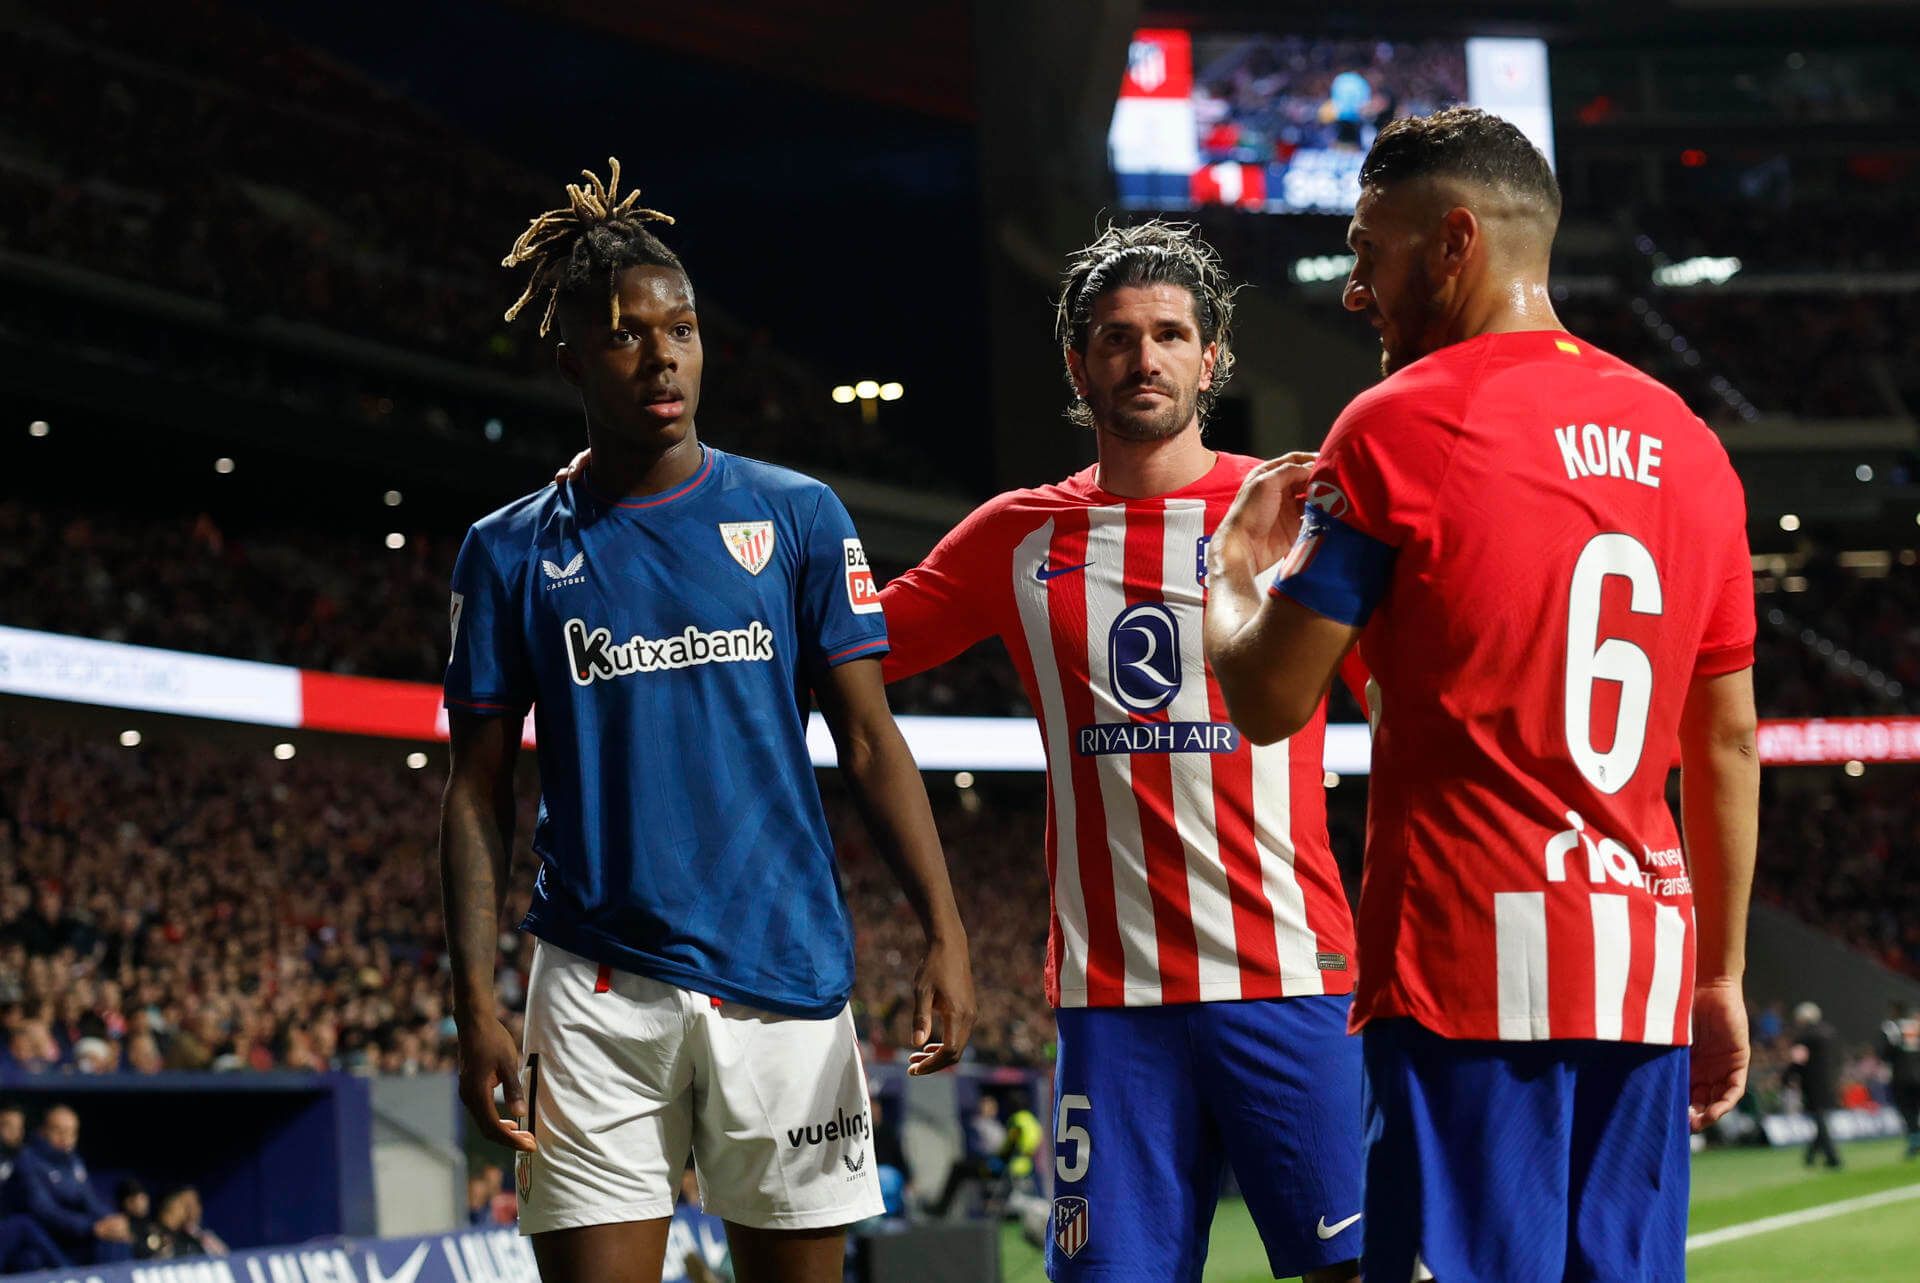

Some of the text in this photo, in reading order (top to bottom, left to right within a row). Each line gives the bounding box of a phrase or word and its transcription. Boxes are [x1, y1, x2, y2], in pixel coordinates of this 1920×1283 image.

[1555, 423, 1663, 488] KOKE
[546, 576, 586, 591] CASTORE
[567, 621, 771, 682] Kutxabank
[1564, 532, 1663, 795] 6
[1081, 725, 1233, 753] RIYADH AIR
[1545, 810, 1645, 888] ria
[787, 1106, 870, 1149] vueling
[1055, 1094, 1092, 1183] 5
